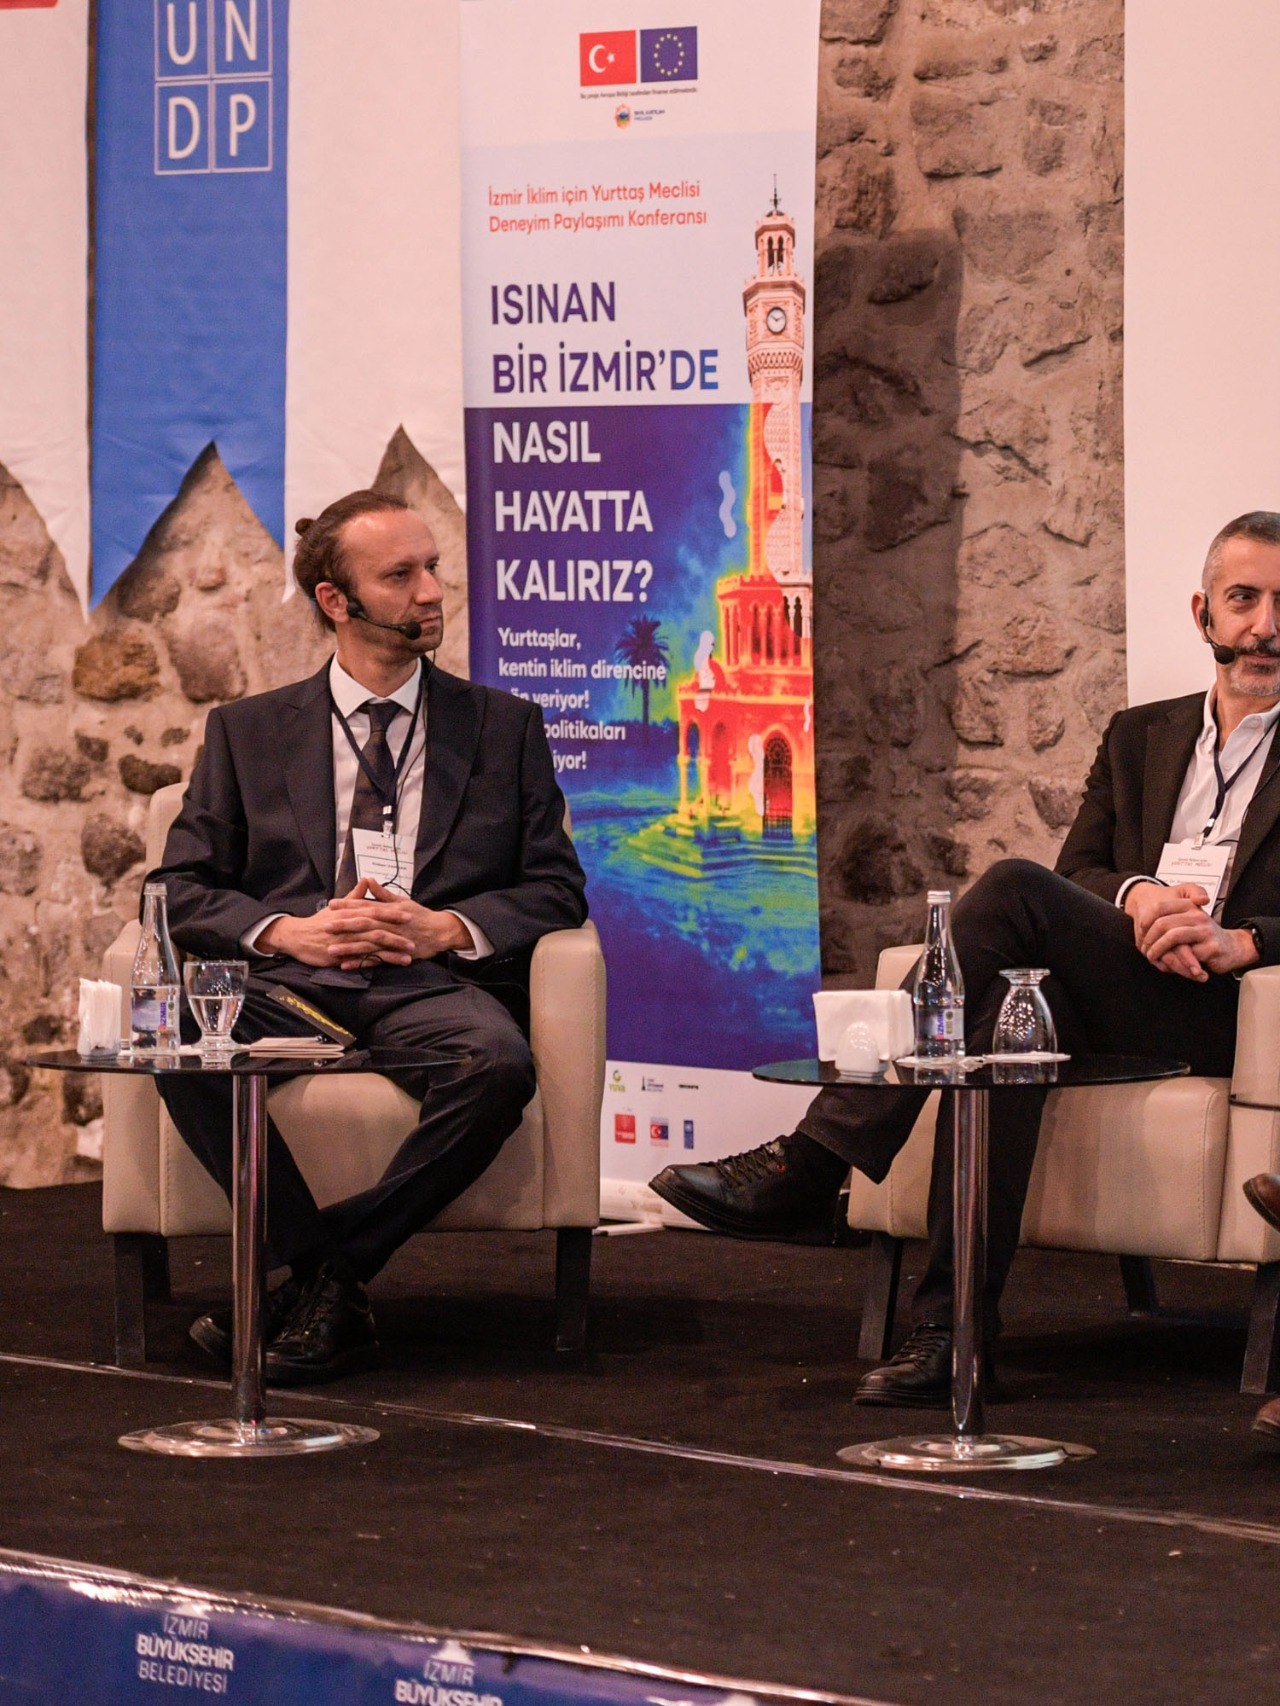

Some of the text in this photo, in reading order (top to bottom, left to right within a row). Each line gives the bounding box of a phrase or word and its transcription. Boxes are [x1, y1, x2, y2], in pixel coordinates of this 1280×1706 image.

[488, 180, 701, 206] İzmir İklim için Yurttaş Meclisi
[489, 208, 707, 235] Deneyim Paylaşımı Konferansı
[491, 281, 616, 325] ISINAN
[493, 339, 719, 393] BİR İZMİR'DE
[493, 420, 601, 463] NASIL
[495, 490, 653, 532] HAYATTA
[496, 559, 653, 602] KALIRIZ?
[497, 627, 581, 651] Yurttaşlar,
[498, 658, 667, 680] kentin iklim direncine
